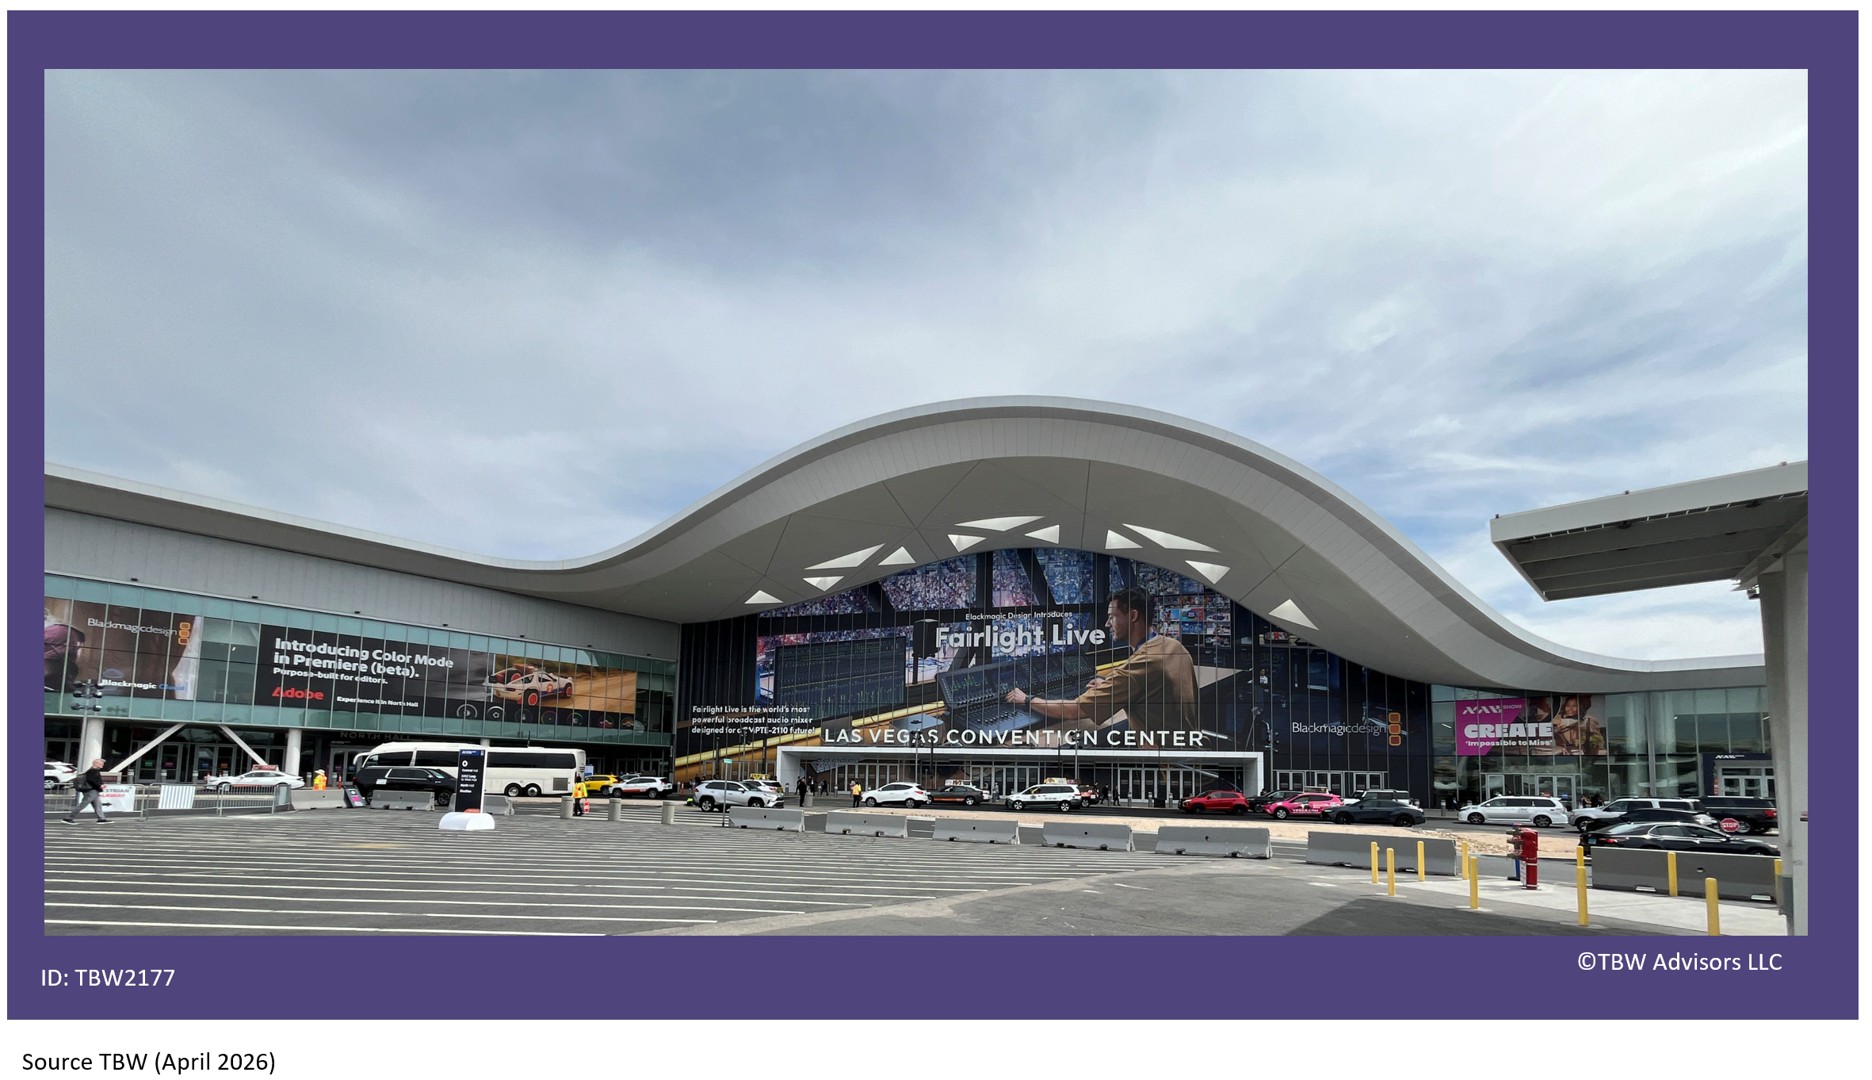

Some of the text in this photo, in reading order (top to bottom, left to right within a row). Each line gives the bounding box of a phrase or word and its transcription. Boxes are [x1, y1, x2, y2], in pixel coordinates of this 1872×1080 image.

[935, 623, 1106, 653] Fairlight Live
[275, 637, 454, 668] Introducing Color Mode
[273, 651, 420, 678] in Premiere (beta).
[273, 667, 339, 680] Purpose-built
[101, 679, 157, 690] Blackmagic
[272, 686, 324, 700] Adobe
[724, 705, 740, 713] Live
[741, 705, 748, 713] is
[749, 705, 761, 713] the
[692, 715, 725, 725] powerful
[340, 731, 381, 740] NORTH
[1292, 721, 1387, 736] Blackmagicdesign
[1464, 722, 1553, 739] CREATE
[824, 728, 1204, 747] LAS VEGAS CONVENTION CENTER
